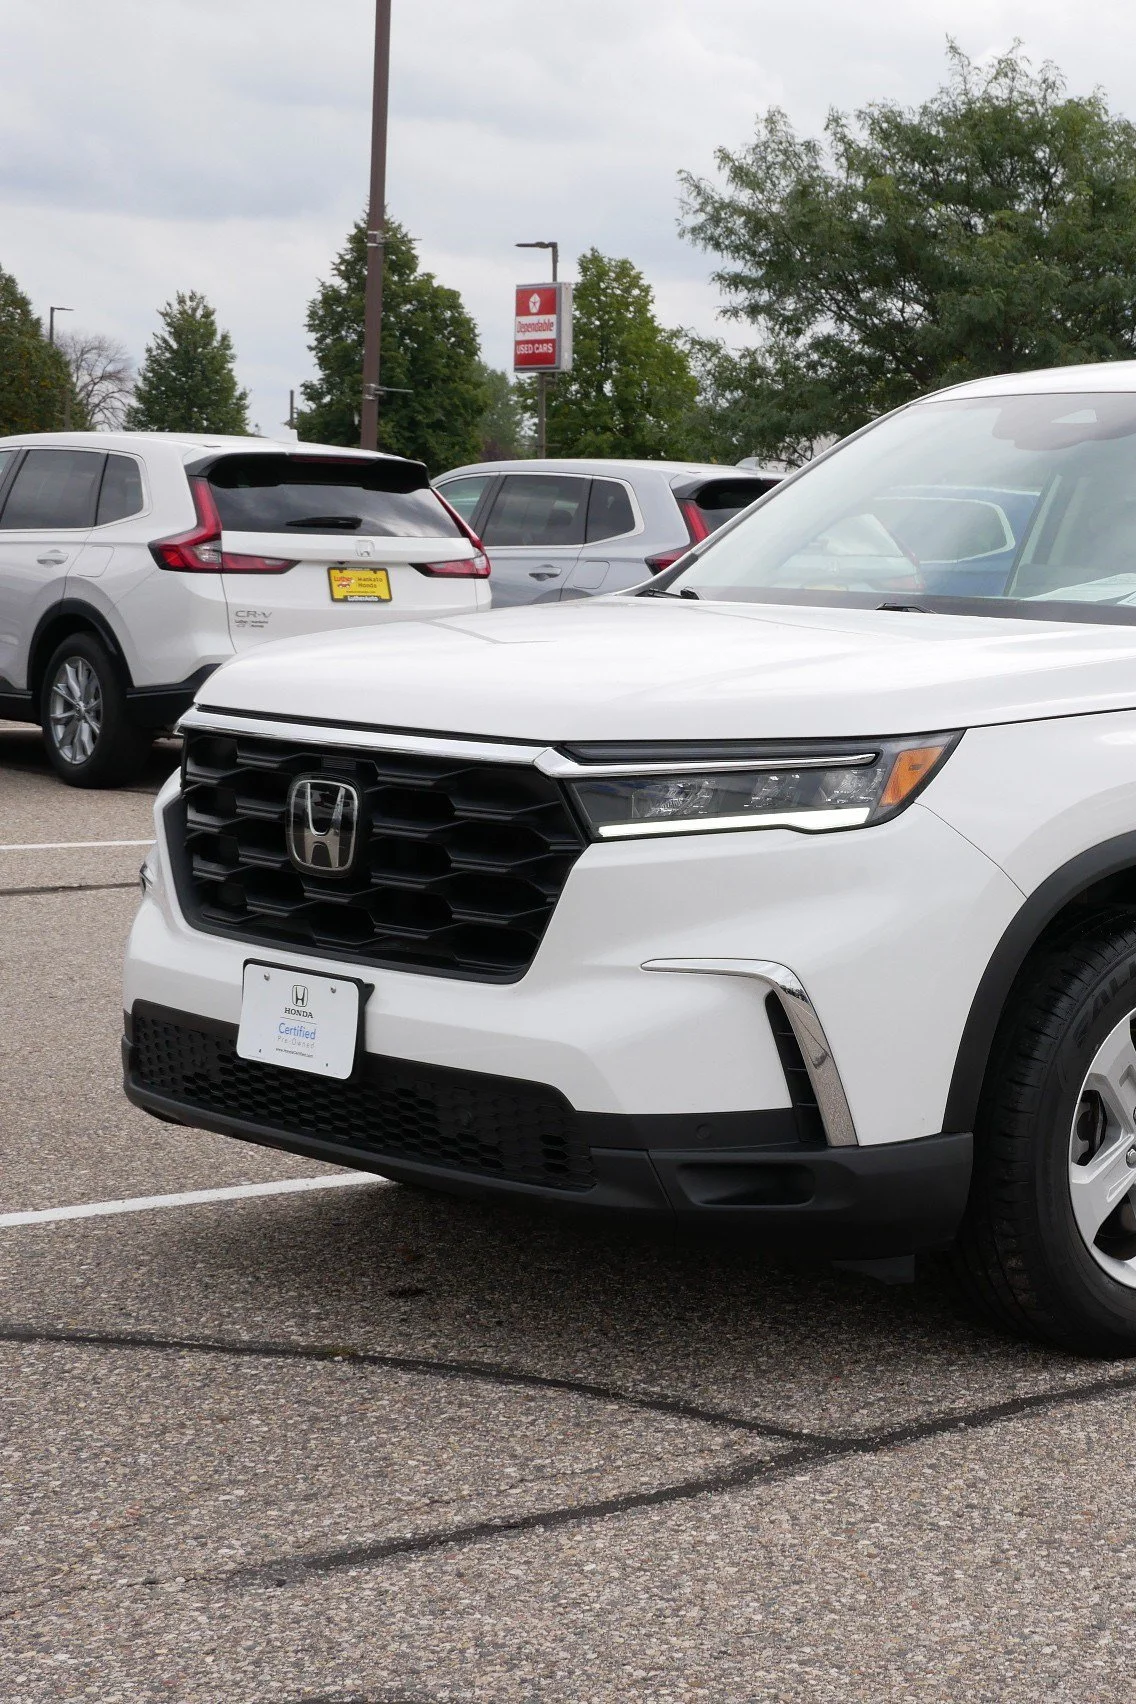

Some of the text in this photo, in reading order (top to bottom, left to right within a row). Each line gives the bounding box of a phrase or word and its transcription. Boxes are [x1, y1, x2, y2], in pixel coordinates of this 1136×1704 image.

[517, 319, 554, 335] Dependable
[516, 343, 553, 354] USED CARS
[235, 610, 273, 618] CR-V
[284, 1007, 314, 1018] HONDA
[278, 1022, 317, 1040] Certified
[277, 1035, 315, 1049] Pre-Owned
